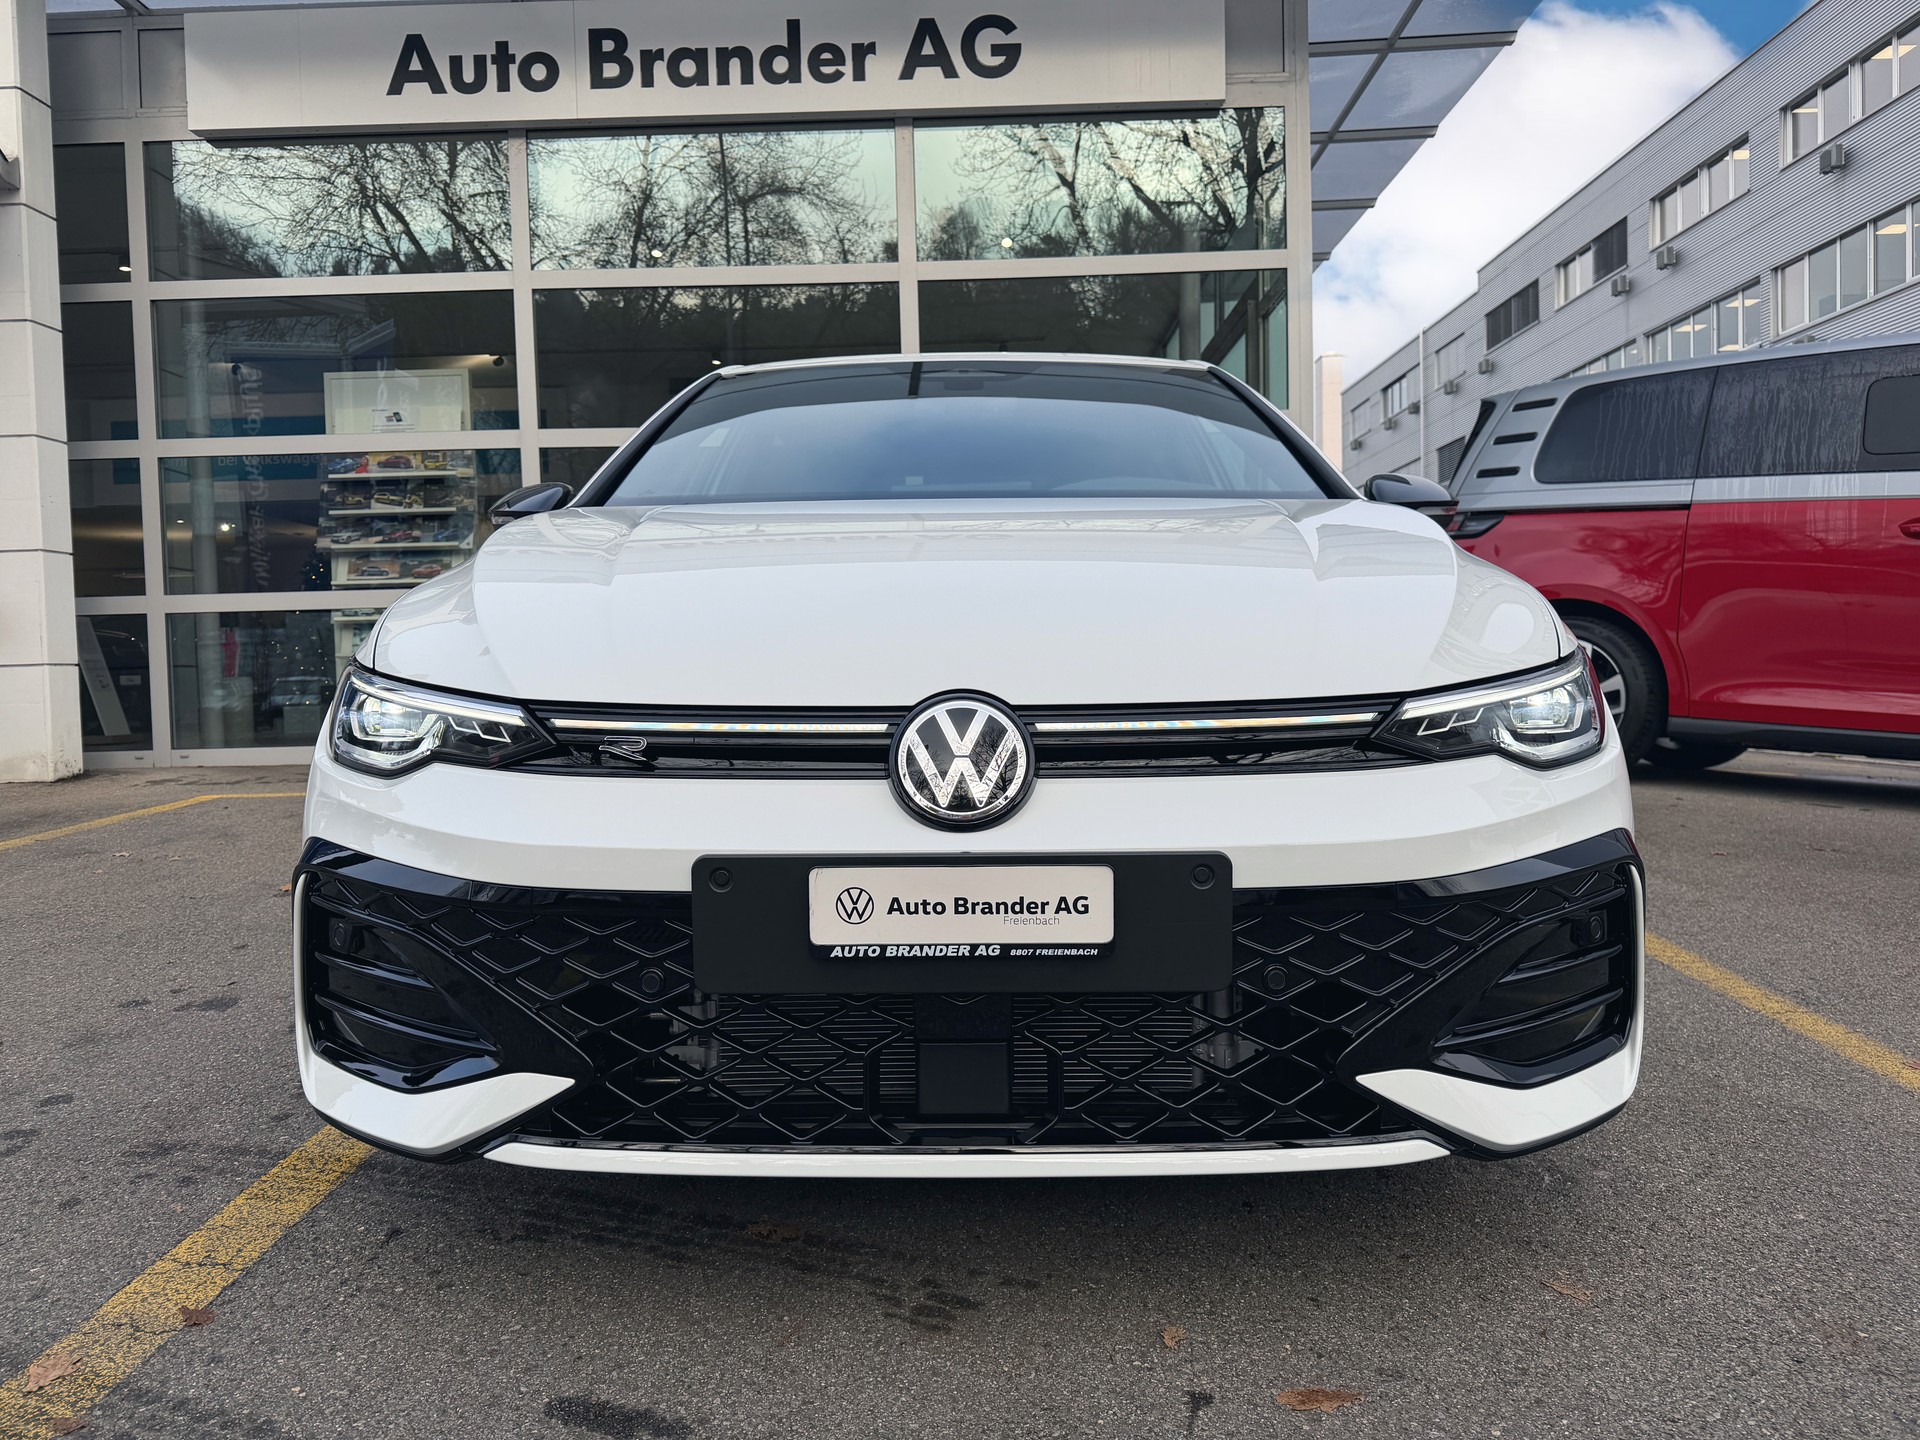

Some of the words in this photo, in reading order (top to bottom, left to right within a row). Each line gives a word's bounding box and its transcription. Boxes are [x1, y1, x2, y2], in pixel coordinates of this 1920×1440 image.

[386, 33, 559, 96] Auto
[578, 18, 877, 90] Brander
[898, 13, 1022, 81] AG
[887, 896, 947, 916] Auto
[954, 896, 1050, 916] Brander
[1054, 896, 1090, 915] AG
[1003, 915, 1060, 926] Freienbach
[830, 945, 880, 957] AUTO
[885, 945, 970, 957] BRANDER
[974, 945, 1001, 956] AG
[1009, 948, 1033, 956] 8807
[1035, 948, 1098, 956] FREIENBACH
